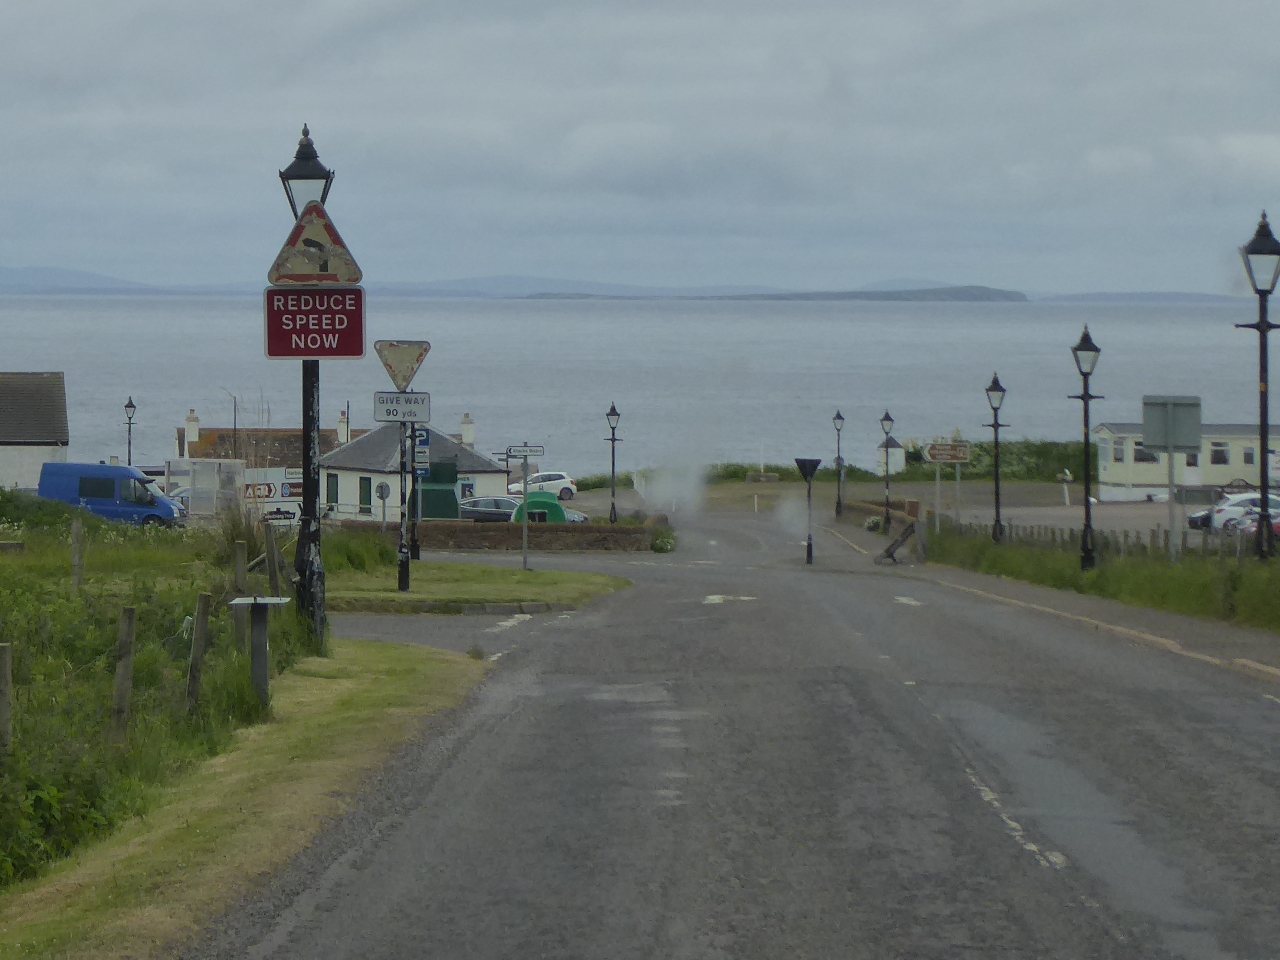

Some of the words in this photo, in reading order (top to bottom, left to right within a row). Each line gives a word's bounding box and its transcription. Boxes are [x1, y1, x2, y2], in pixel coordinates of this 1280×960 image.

[273, 295, 356, 310] REDUCE
[282, 314, 348, 330] SPEED
[291, 333, 339, 349] NOW
[378, 396, 401, 405] GIVE
[404, 397, 426, 405] WAY
[385, 408, 399, 417] 90
[401, 409, 417, 418] yds
